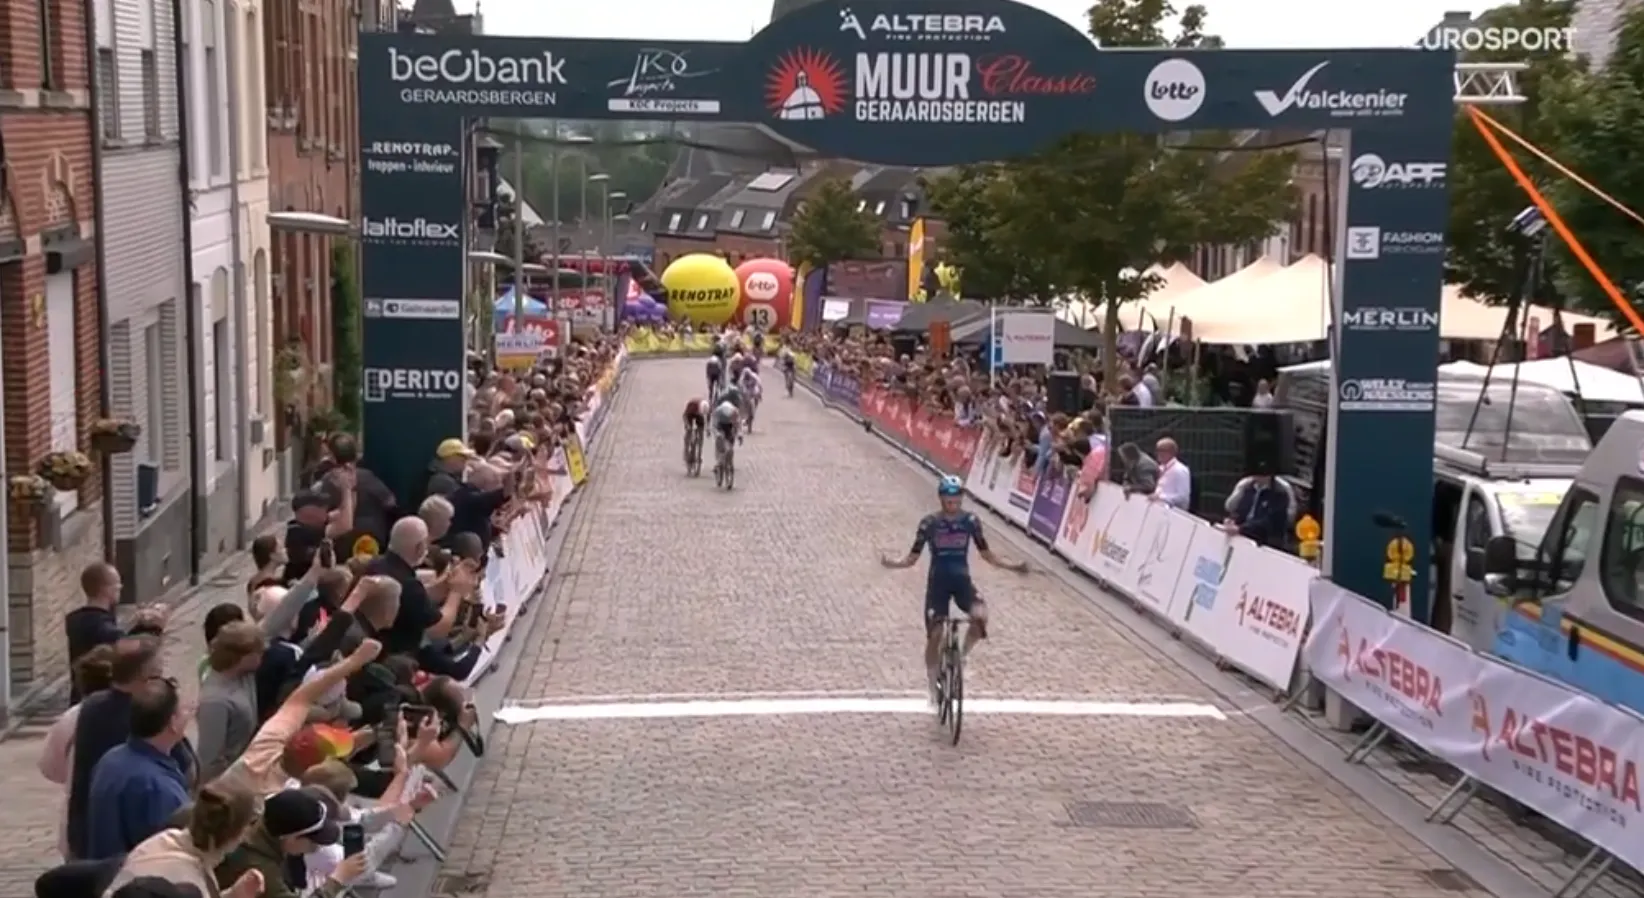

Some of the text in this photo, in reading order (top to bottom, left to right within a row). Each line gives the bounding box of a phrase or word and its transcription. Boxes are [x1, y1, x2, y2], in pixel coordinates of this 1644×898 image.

[871, 14, 1006, 33] ALTEBRA
[855, 52, 1097, 99] MUUR Classic
[400, 87, 557, 106] GERAARDSBERGEN
[855, 101, 1025, 122] GERAARDSBERGEN
[372, 141, 452, 156] RENOTRAP
[1382, 231, 1443, 243] FASHION
[751, 309, 769, 328] 13
[1343, 310, 1438, 325] MERLIN
[378, 368, 460, 390] DERITO
[1247, 596, 1300, 637] ALTEBRA
[1355, 637, 1443, 717] ALTEBRA
[1497, 707, 1642, 813] ALTEBRA
